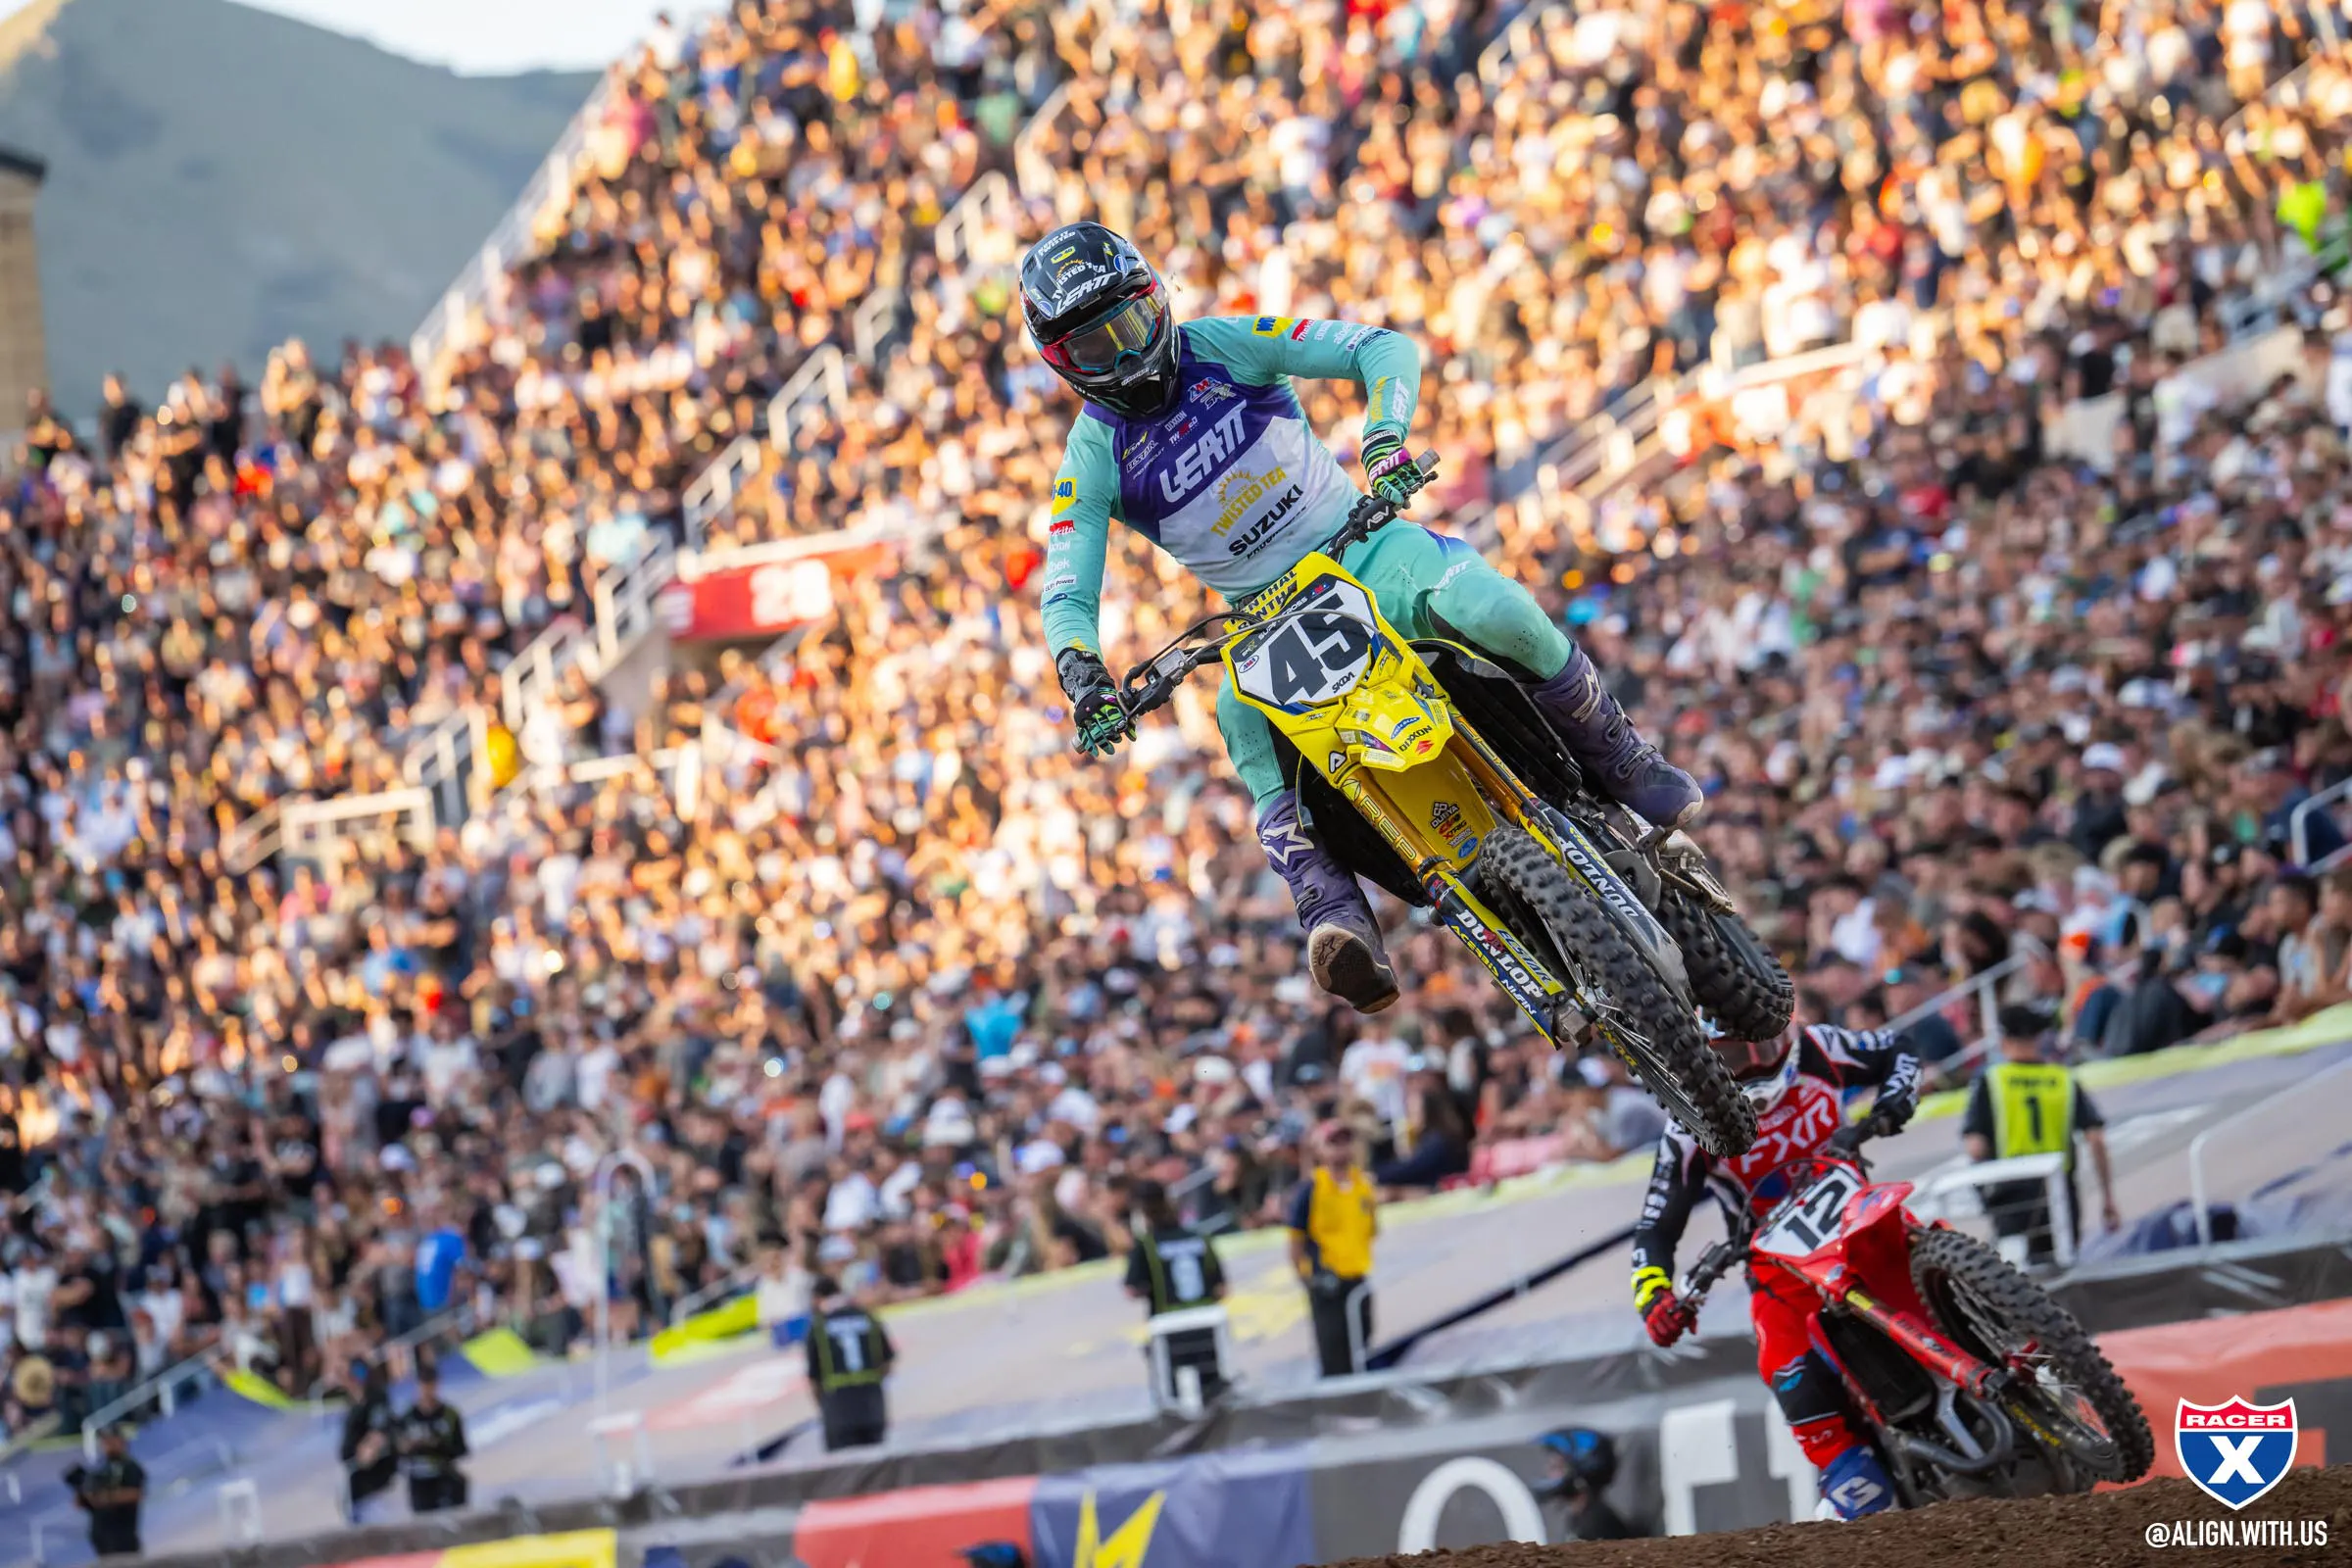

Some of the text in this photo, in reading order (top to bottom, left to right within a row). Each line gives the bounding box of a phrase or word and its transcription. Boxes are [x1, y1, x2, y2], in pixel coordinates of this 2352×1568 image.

[1056, 271, 1118, 318] LEATT
[1159, 399, 1247, 504] LEATT
[1164, 411, 1188, 432] DIXXON
[1211, 483, 1262, 538] TWISTED
[1261, 466, 1286, 490] TEA
[1229, 484, 1303, 556] SUZUKI
[1367, 506, 1390, 529] ASV
[1268, 593, 1373, 705] 45
[1332, 671, 1355, 694] SKDA
[1398, 725, 1433, 752] DIXXON
[1359, 795, 1416, 860] REP
[1450, 924, 1500, 978] ACERBIS
[1456, 909, 1545, 998] DUNLOP
[1496, 928, 1552, 986] ECSTAR
[1740, 1096, 1836, 1174] FXR
[1785, 1179, 1847, 1250] 12
